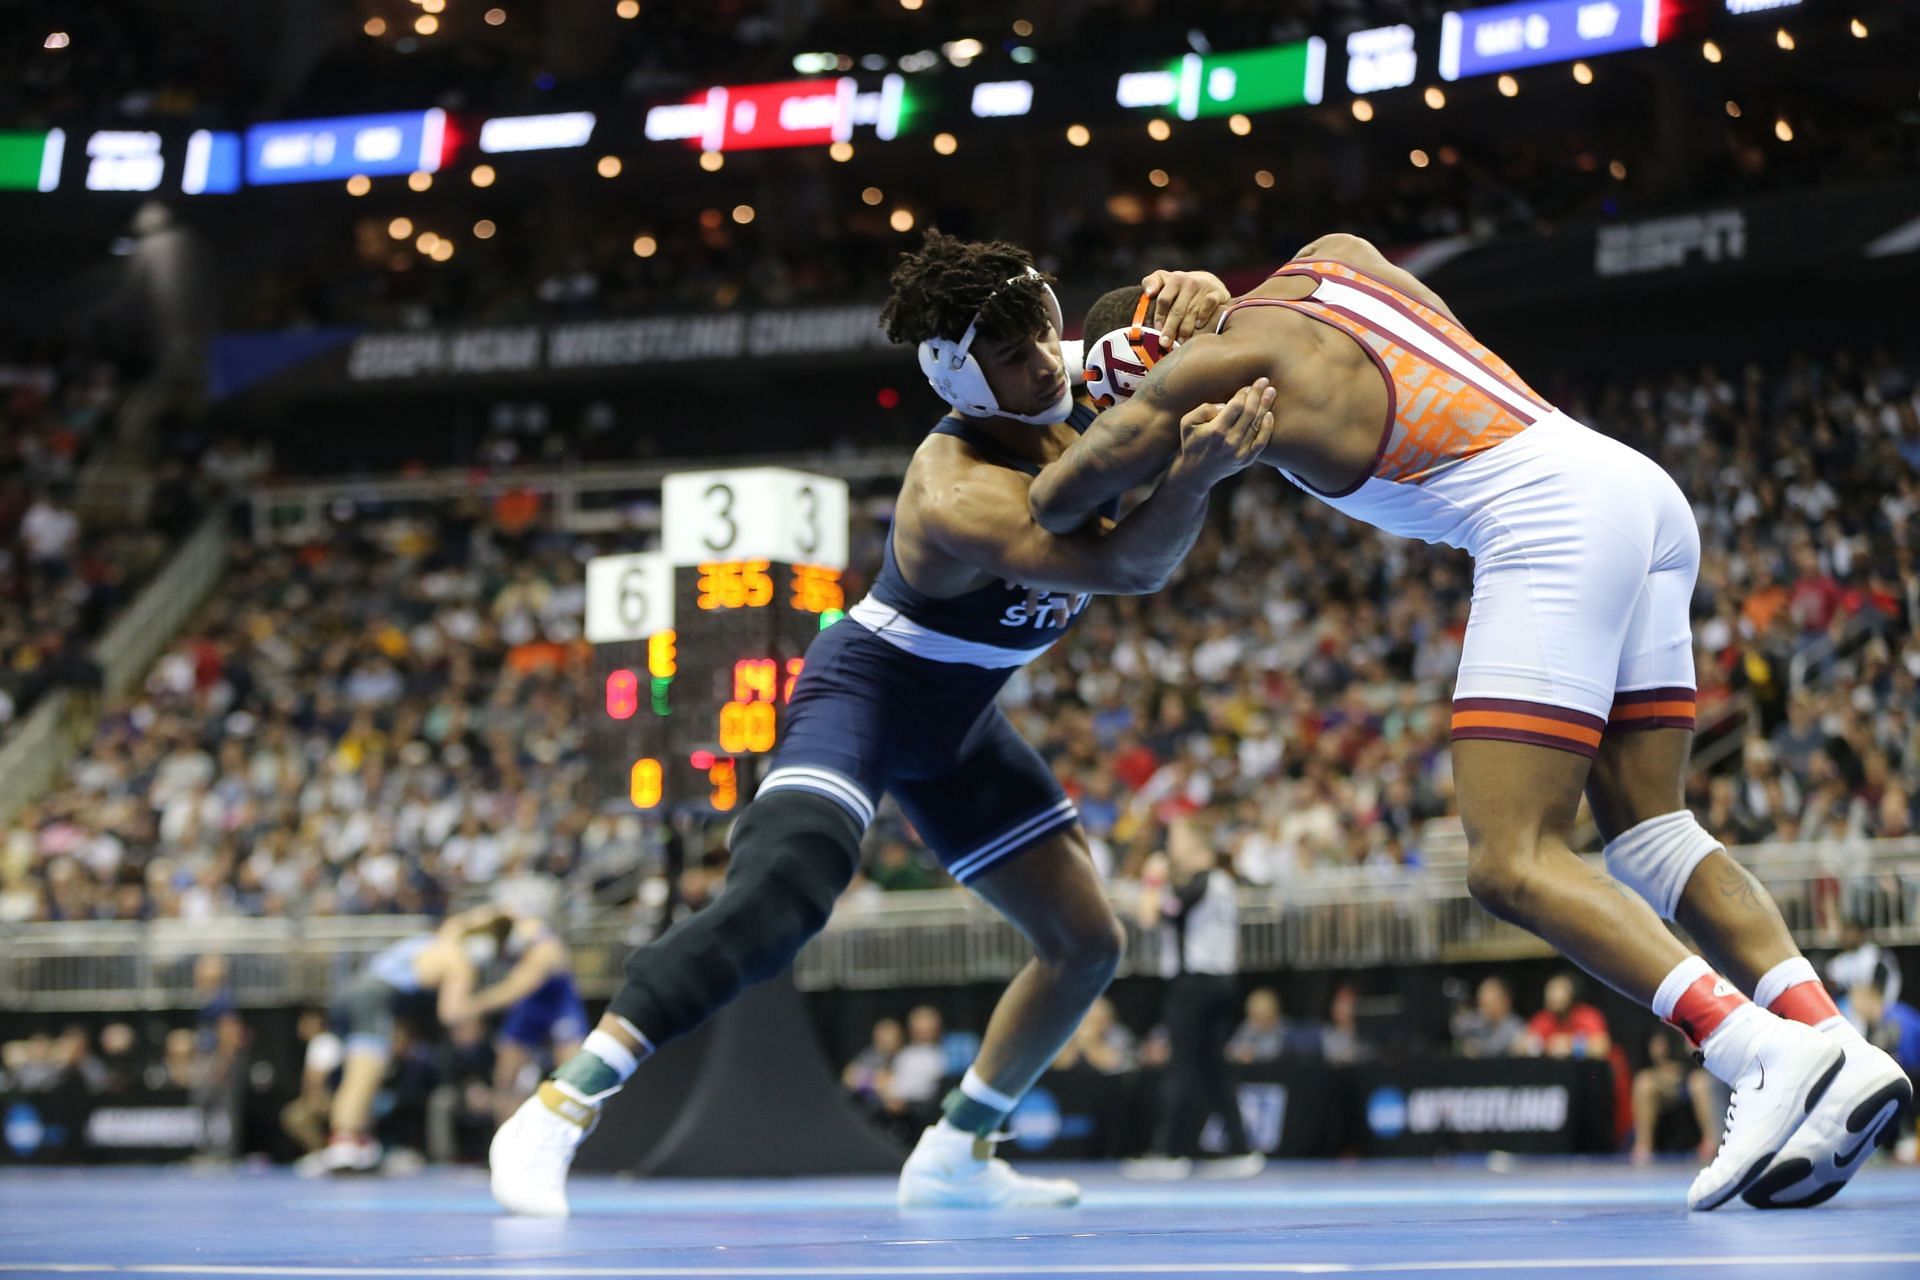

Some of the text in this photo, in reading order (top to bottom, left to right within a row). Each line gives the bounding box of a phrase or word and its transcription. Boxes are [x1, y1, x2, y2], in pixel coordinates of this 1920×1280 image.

[1596, 211, 1744, 275] ESPN
[702, 483, 738, 551] 3
[793, 485, 819, 553] 3
[617, 567, 648, 628] 6
